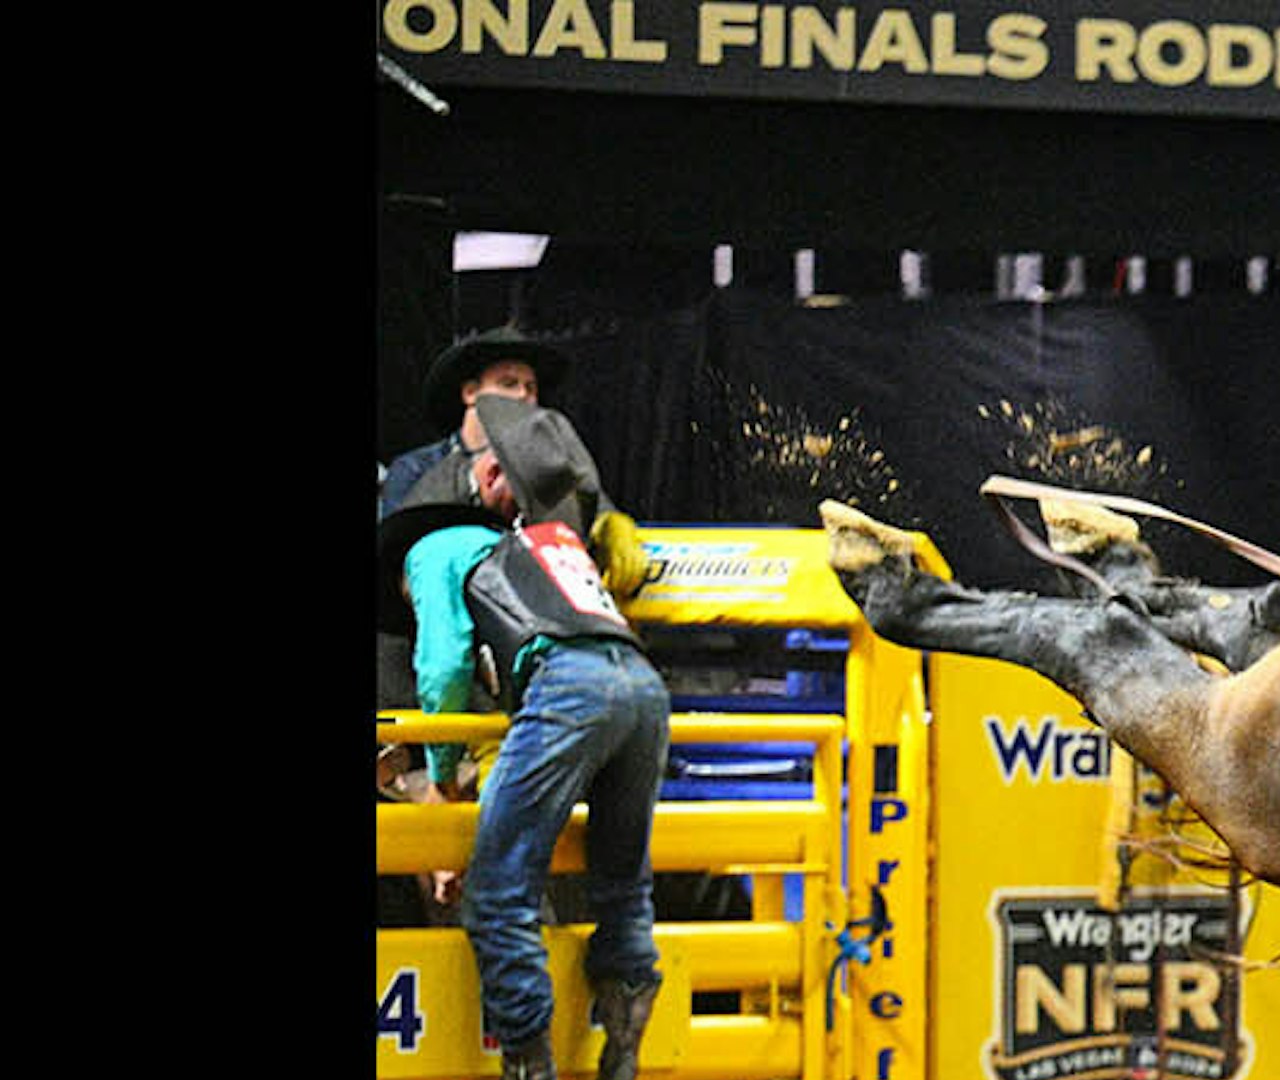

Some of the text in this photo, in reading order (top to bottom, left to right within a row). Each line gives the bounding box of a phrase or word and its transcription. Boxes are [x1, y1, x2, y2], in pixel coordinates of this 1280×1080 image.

[698, 4, 1049, 80] FINALS
[377, 969, 423, 1050] 4
[1015, 963, 1221, 1035] NFR
